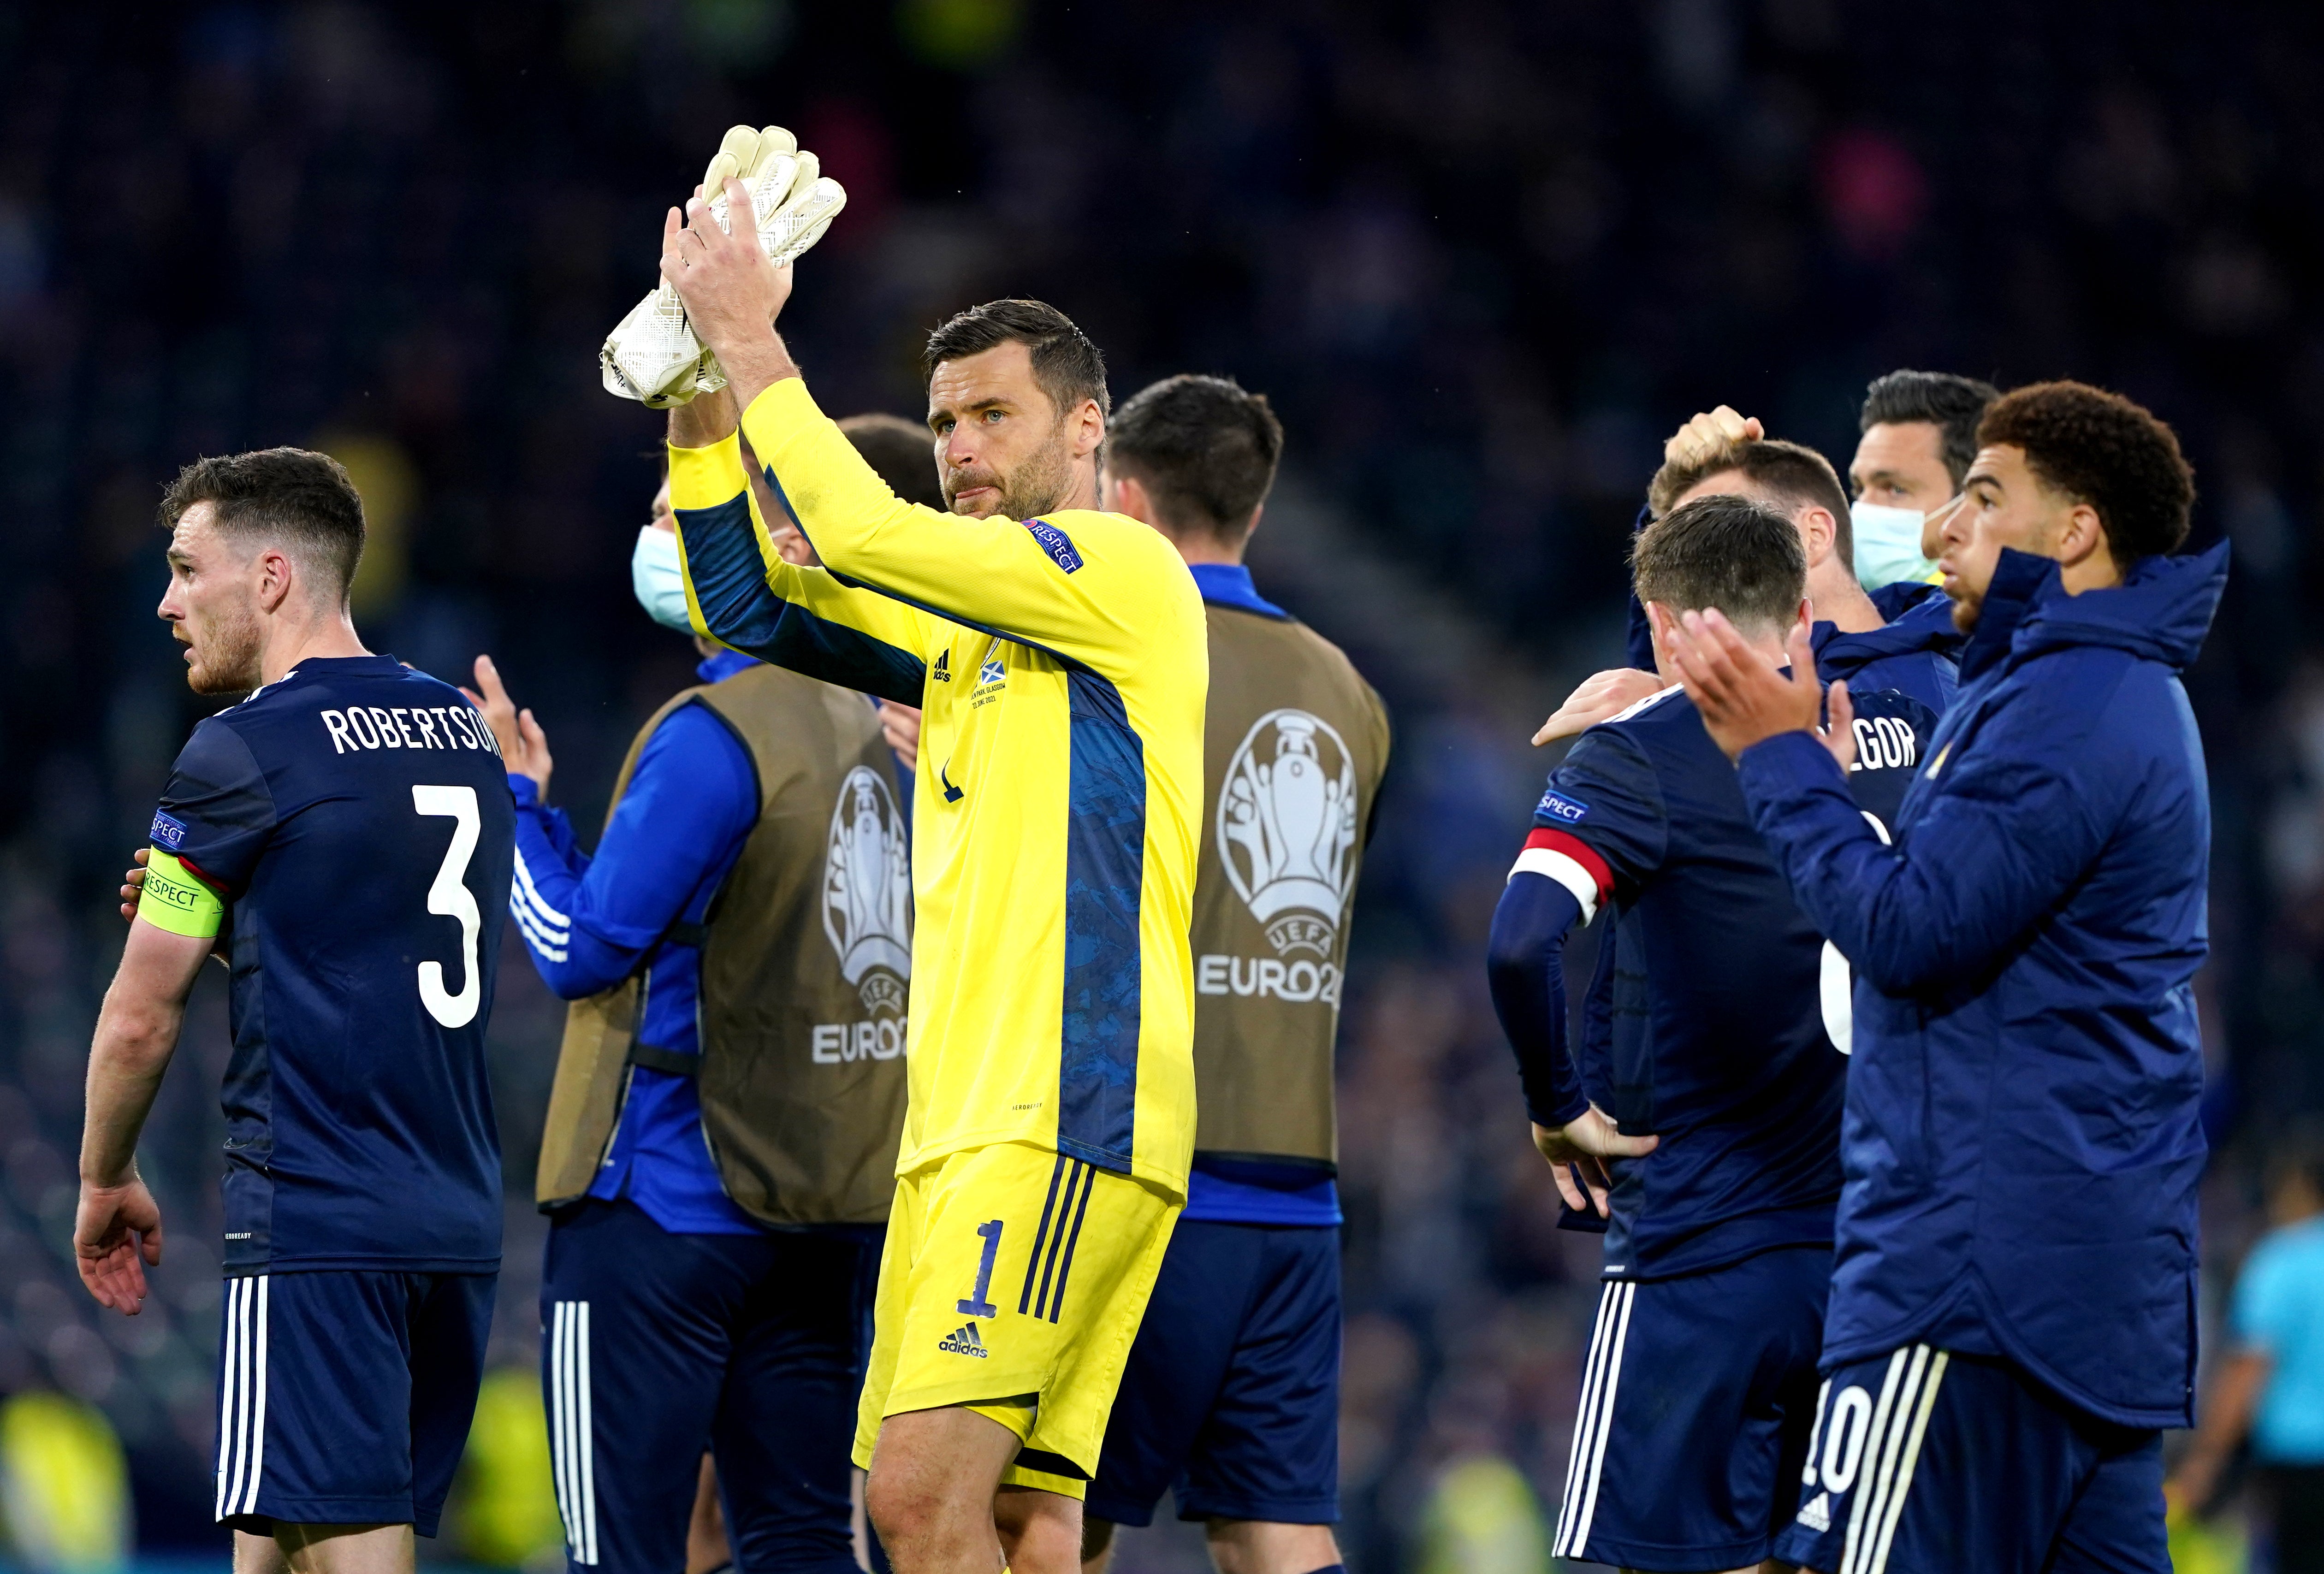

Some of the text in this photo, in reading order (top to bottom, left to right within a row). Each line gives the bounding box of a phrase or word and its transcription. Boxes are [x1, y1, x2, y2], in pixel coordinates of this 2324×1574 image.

[1032, 526, 1077, 571] RESPECT
[985, 695, 996, 704] 2021
[986, 682, 1006, 693] GLASGOW
[1850, 716, 1915, 771] GOR
[145, 872, 199, 906] RESPECT
[411, 784, 481, 1028] 3
[1269, 922, 1333, 956] UEFA
[1012, 1102, 1042, 1111] AEROREADY
[955, 1219, 1003, 1318] 1
[939, 1340, 988, 1358] adidas
